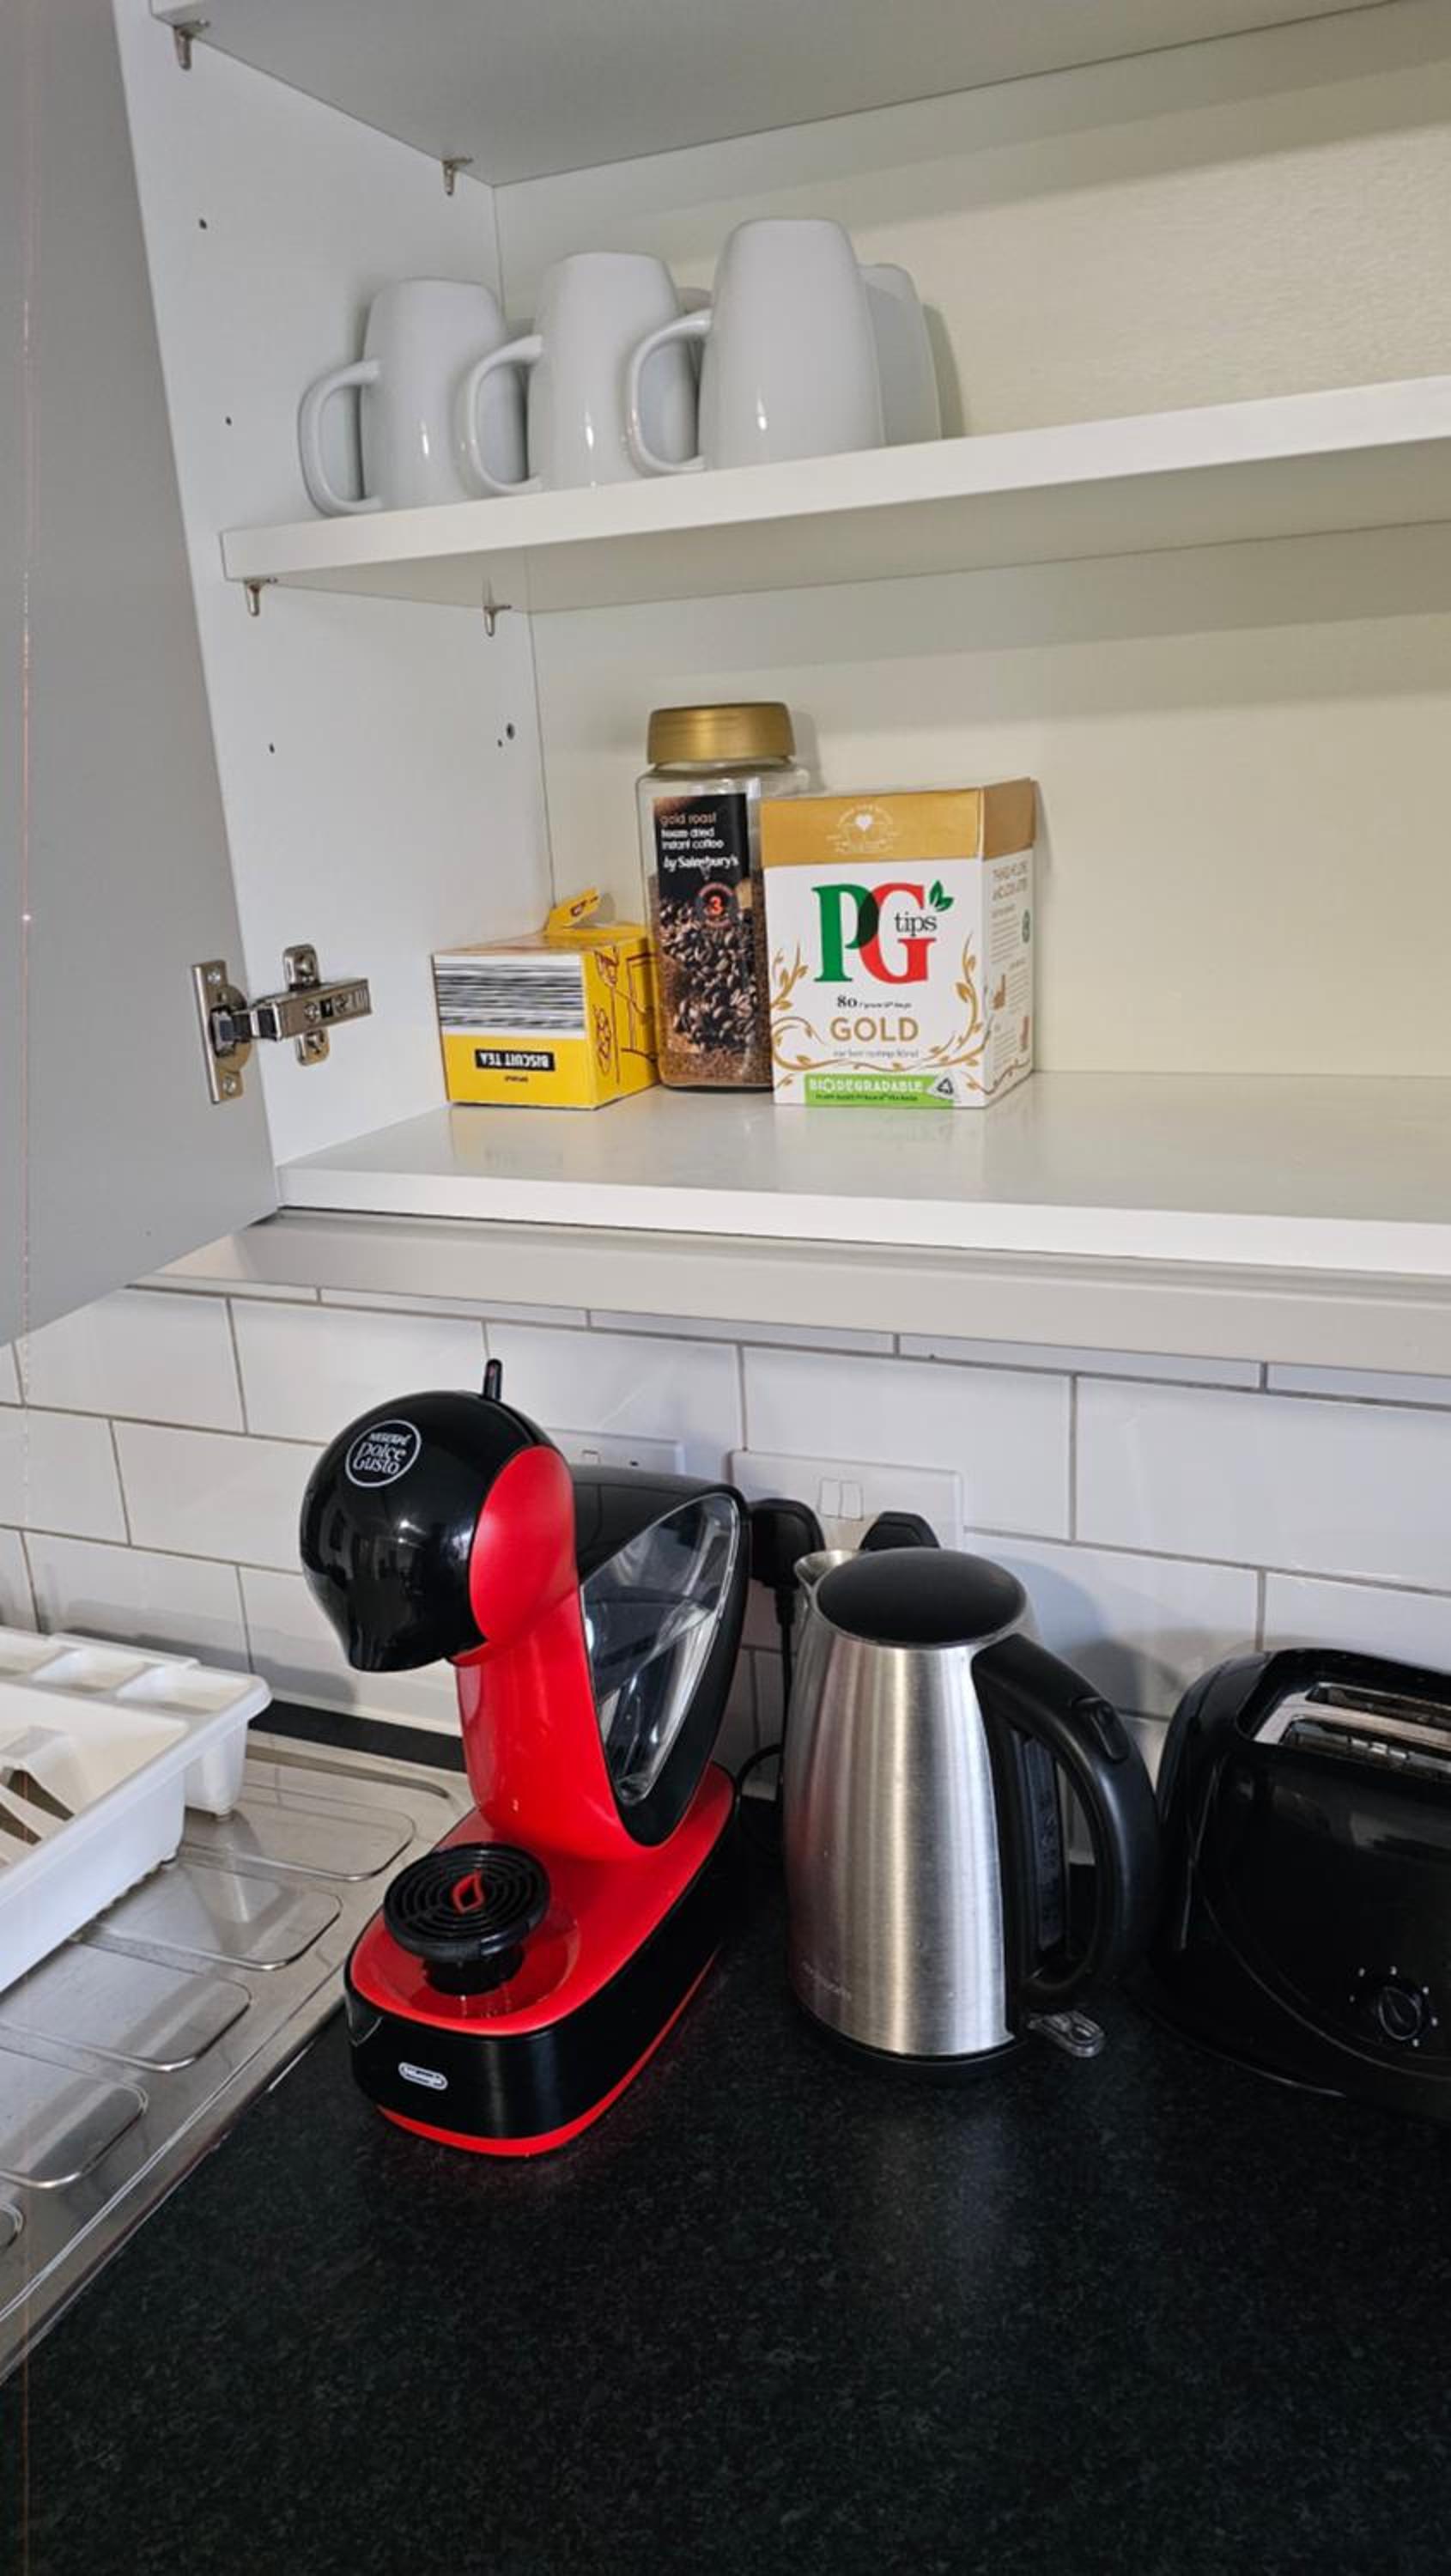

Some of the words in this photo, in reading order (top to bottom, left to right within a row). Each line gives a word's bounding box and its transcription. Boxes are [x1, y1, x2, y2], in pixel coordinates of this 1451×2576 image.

[660, 814, 686, 826] gold
[689, 812, 717, 824] roast
[690, 827, 715, 838] dried
[662, 839, 690, 849] instant
[692, 839, 725, 849] coffee
[663, 855, 677, 872] by
[677, 854, 739, 869] Sainsbury's
[710, 896, 723, 914] 3
[894, 911, 938, 938] tips
[811, 882, 937, 985] PG
[836, 995, 858, 1008] 80
[831, 1017, 919, 1042] GOLD
[479, 1052, 502, 1066] TEA
[505, 1053, 549, 1068] BISCUIT
